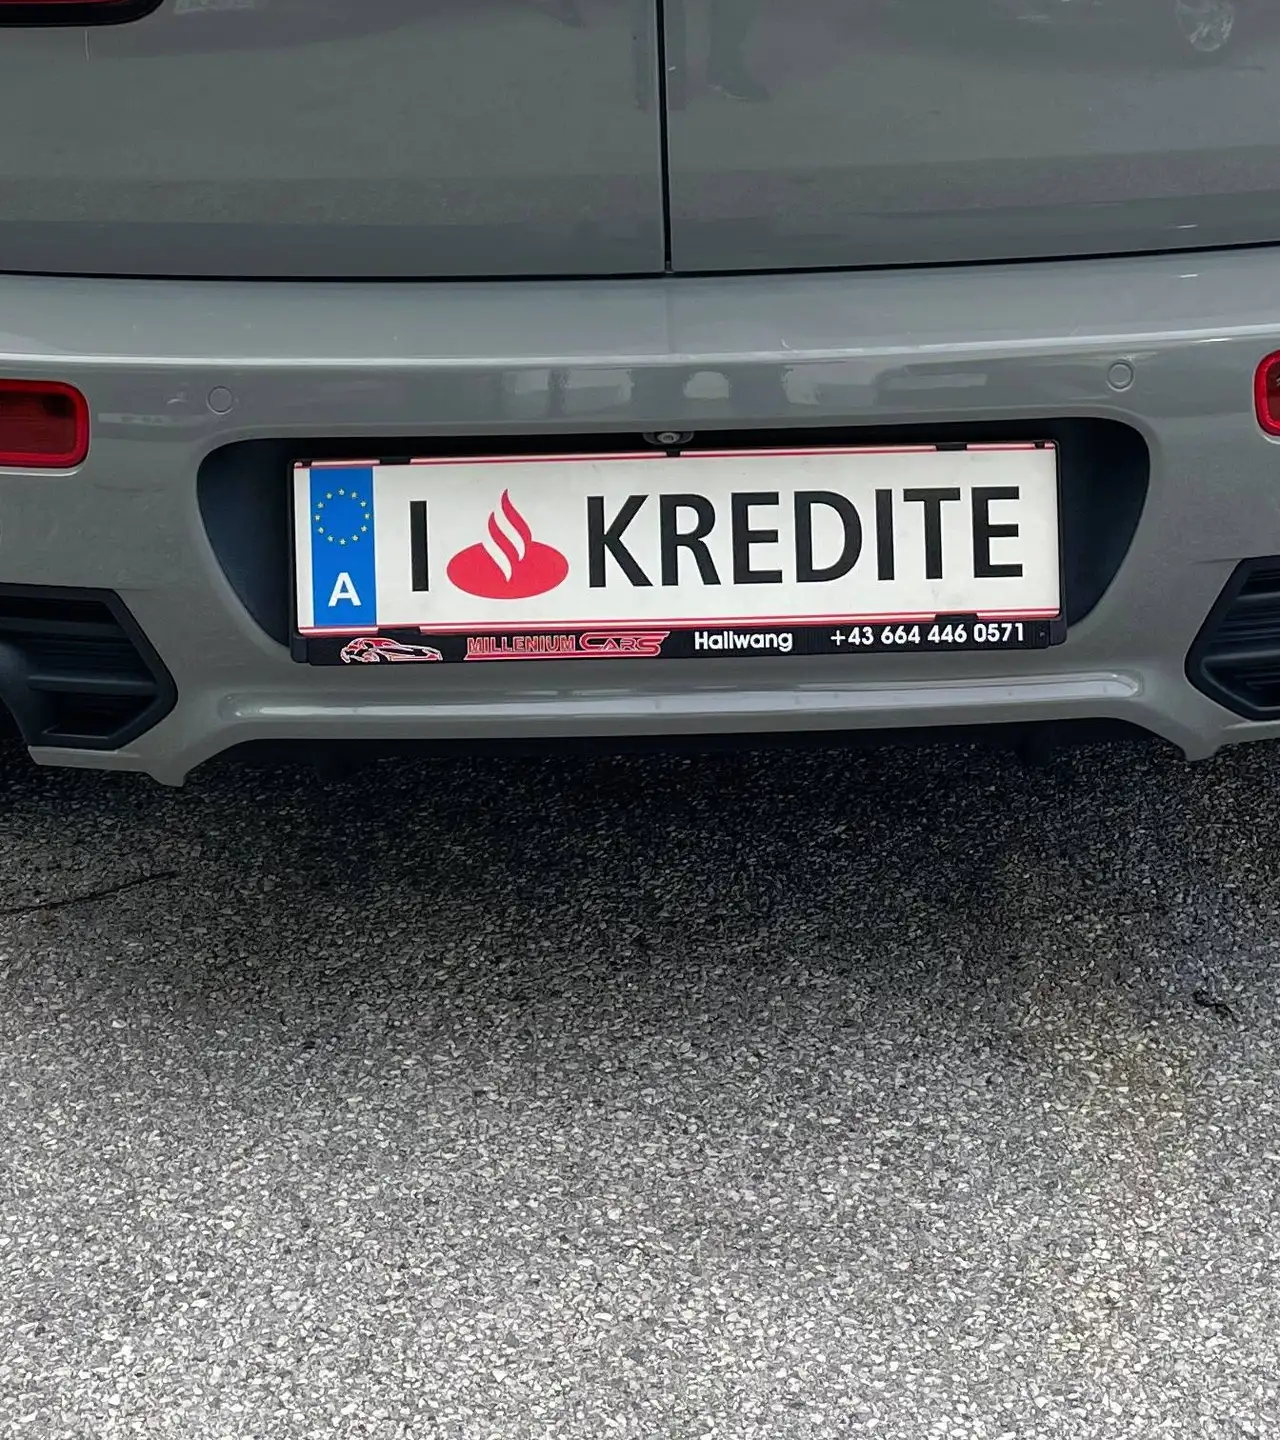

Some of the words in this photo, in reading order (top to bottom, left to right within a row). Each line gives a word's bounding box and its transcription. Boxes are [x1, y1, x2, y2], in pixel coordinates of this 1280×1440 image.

[409, 500, 429, 592] I
[586, 486, 1024, 588] KREDITE
[327, 571, 362, 607] A
[466, 634, 576, 654] MILLENIUM
[694, 630, 793, 652] Hallwang
[830, 626, 874, 647] +43
[881, 625, 921, 645] 664
[927, 624, 968, 644] 446
[974, 623, 1025, 643] 0571
